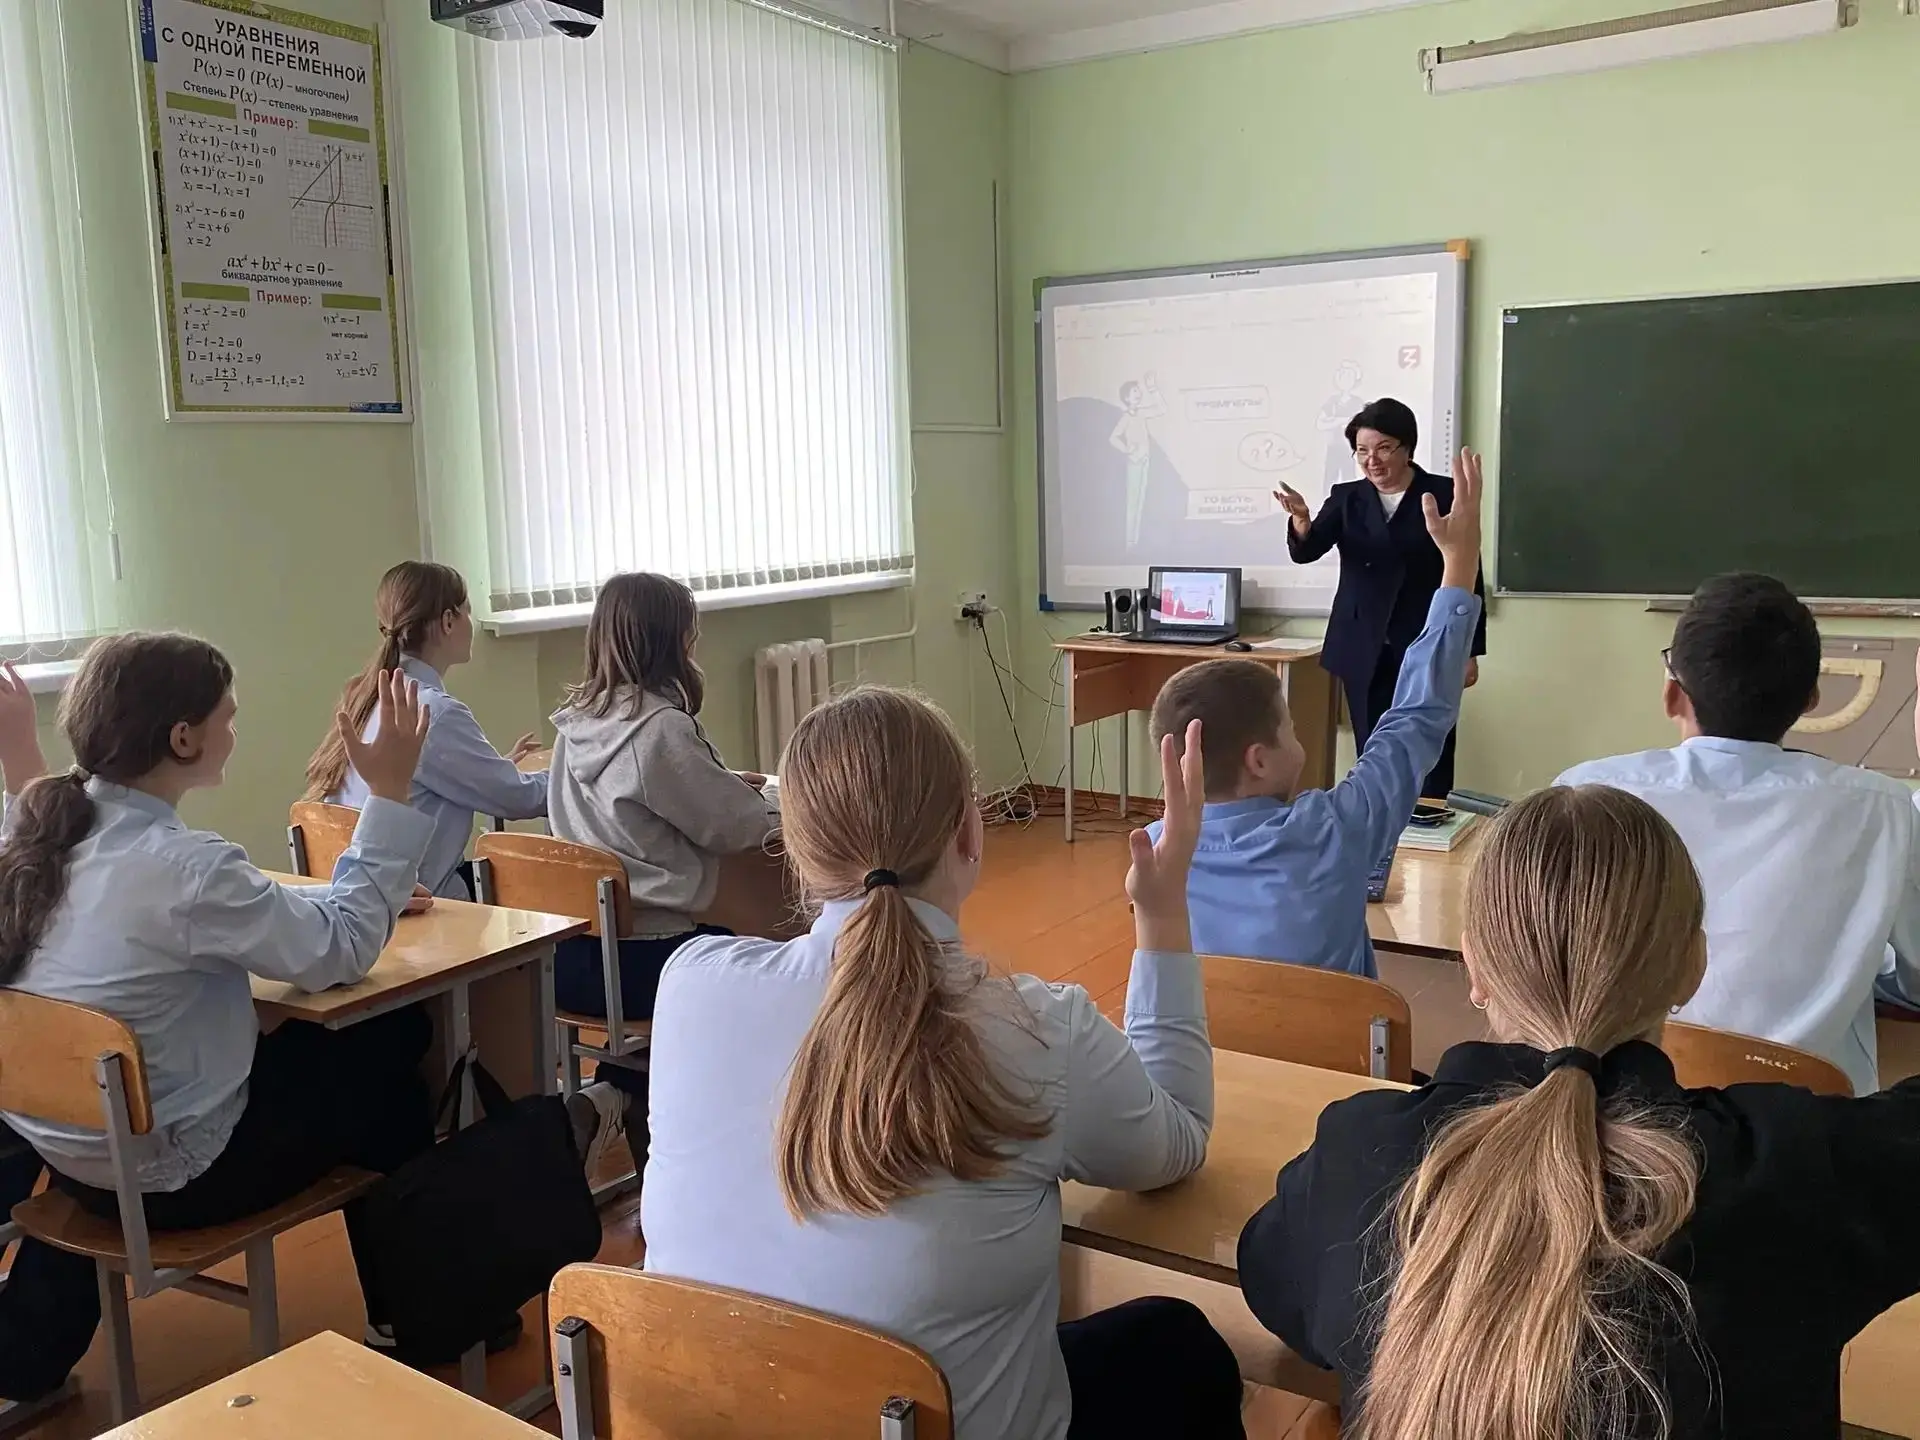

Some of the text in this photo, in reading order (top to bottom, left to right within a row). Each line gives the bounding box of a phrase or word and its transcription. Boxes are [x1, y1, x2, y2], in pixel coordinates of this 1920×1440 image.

[214, 18, 319, 56] УРАВНЕНИЯ
[161, 27, 366, 84] С ОДНОЙ ПЕРЕМЕННОЙ
[183, 80, 227, 98] Степень
[268, 99, 308, 113] степень
[309, 107, 359, 122] уравнения
[243, 108, 299, 131] Пример:
[221, 268, 343, 288] биквадратное уравнение
[256, 290, 312, 307] Пример:
